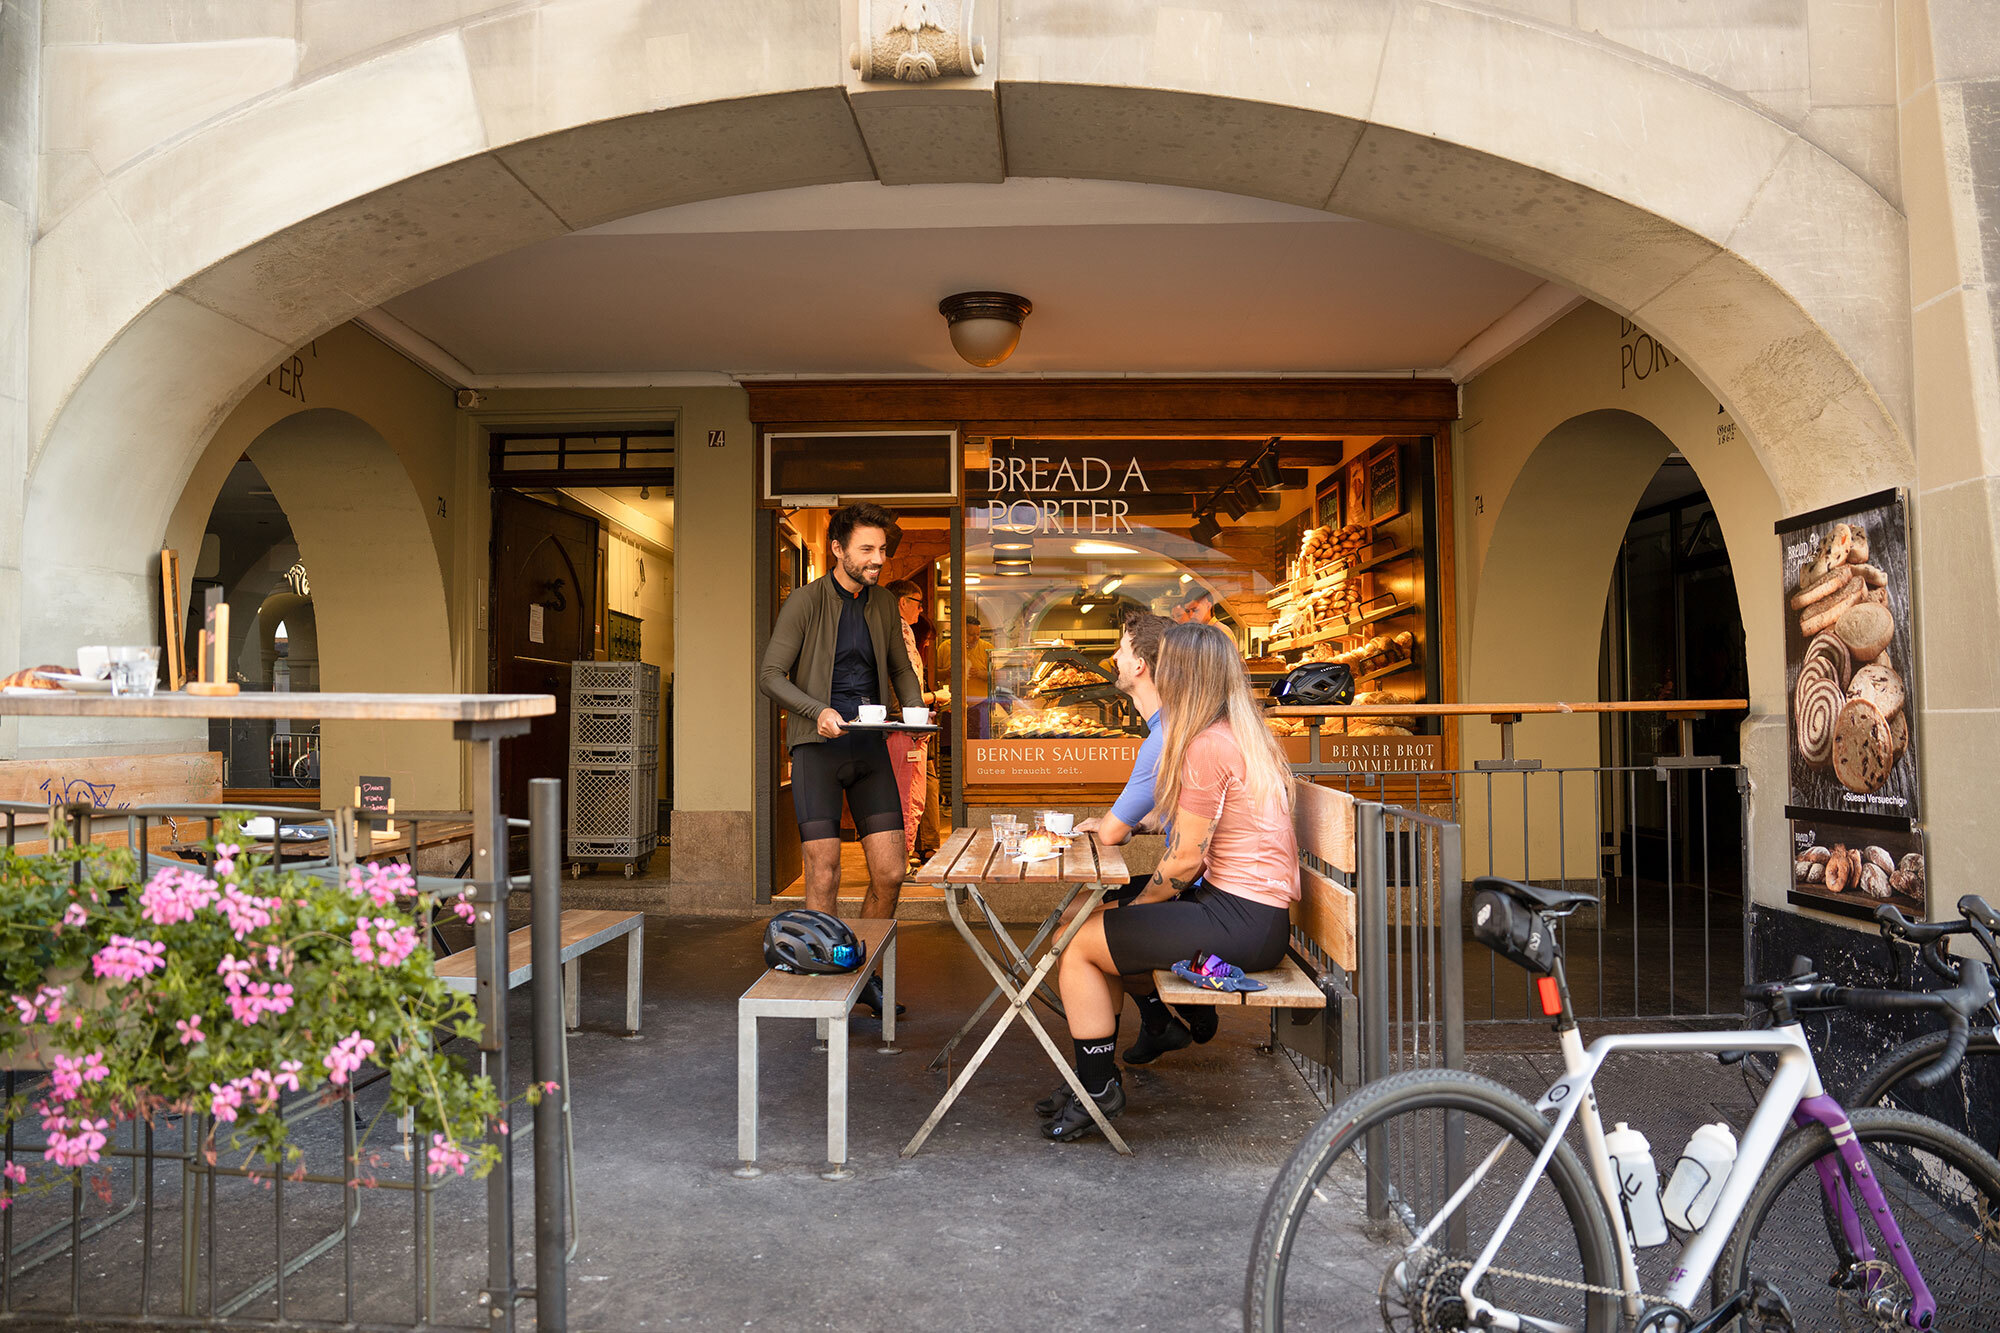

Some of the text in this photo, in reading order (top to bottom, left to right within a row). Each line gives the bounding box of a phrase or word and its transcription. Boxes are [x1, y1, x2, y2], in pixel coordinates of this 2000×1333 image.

[1621, 334, 1679, 390] POR
[267, 355, 306, 403] ER
[709, 431, 725, 447] 74
[987, 456, 1151, 493] BREAD A
[437, 496, 447, 519] 74
[987, 499, 1134, 536] PORTER
[976, 746, 1141, 762] BERNER SAUERTEI
[1332, 744, 1435, 758] BERNER BROT
[976, 766, 1083, 776] Gutes braucht Zeit.
[1854, 1159, 1866, 1172] CF
[1668, 1266, 1689, 1283] CF
